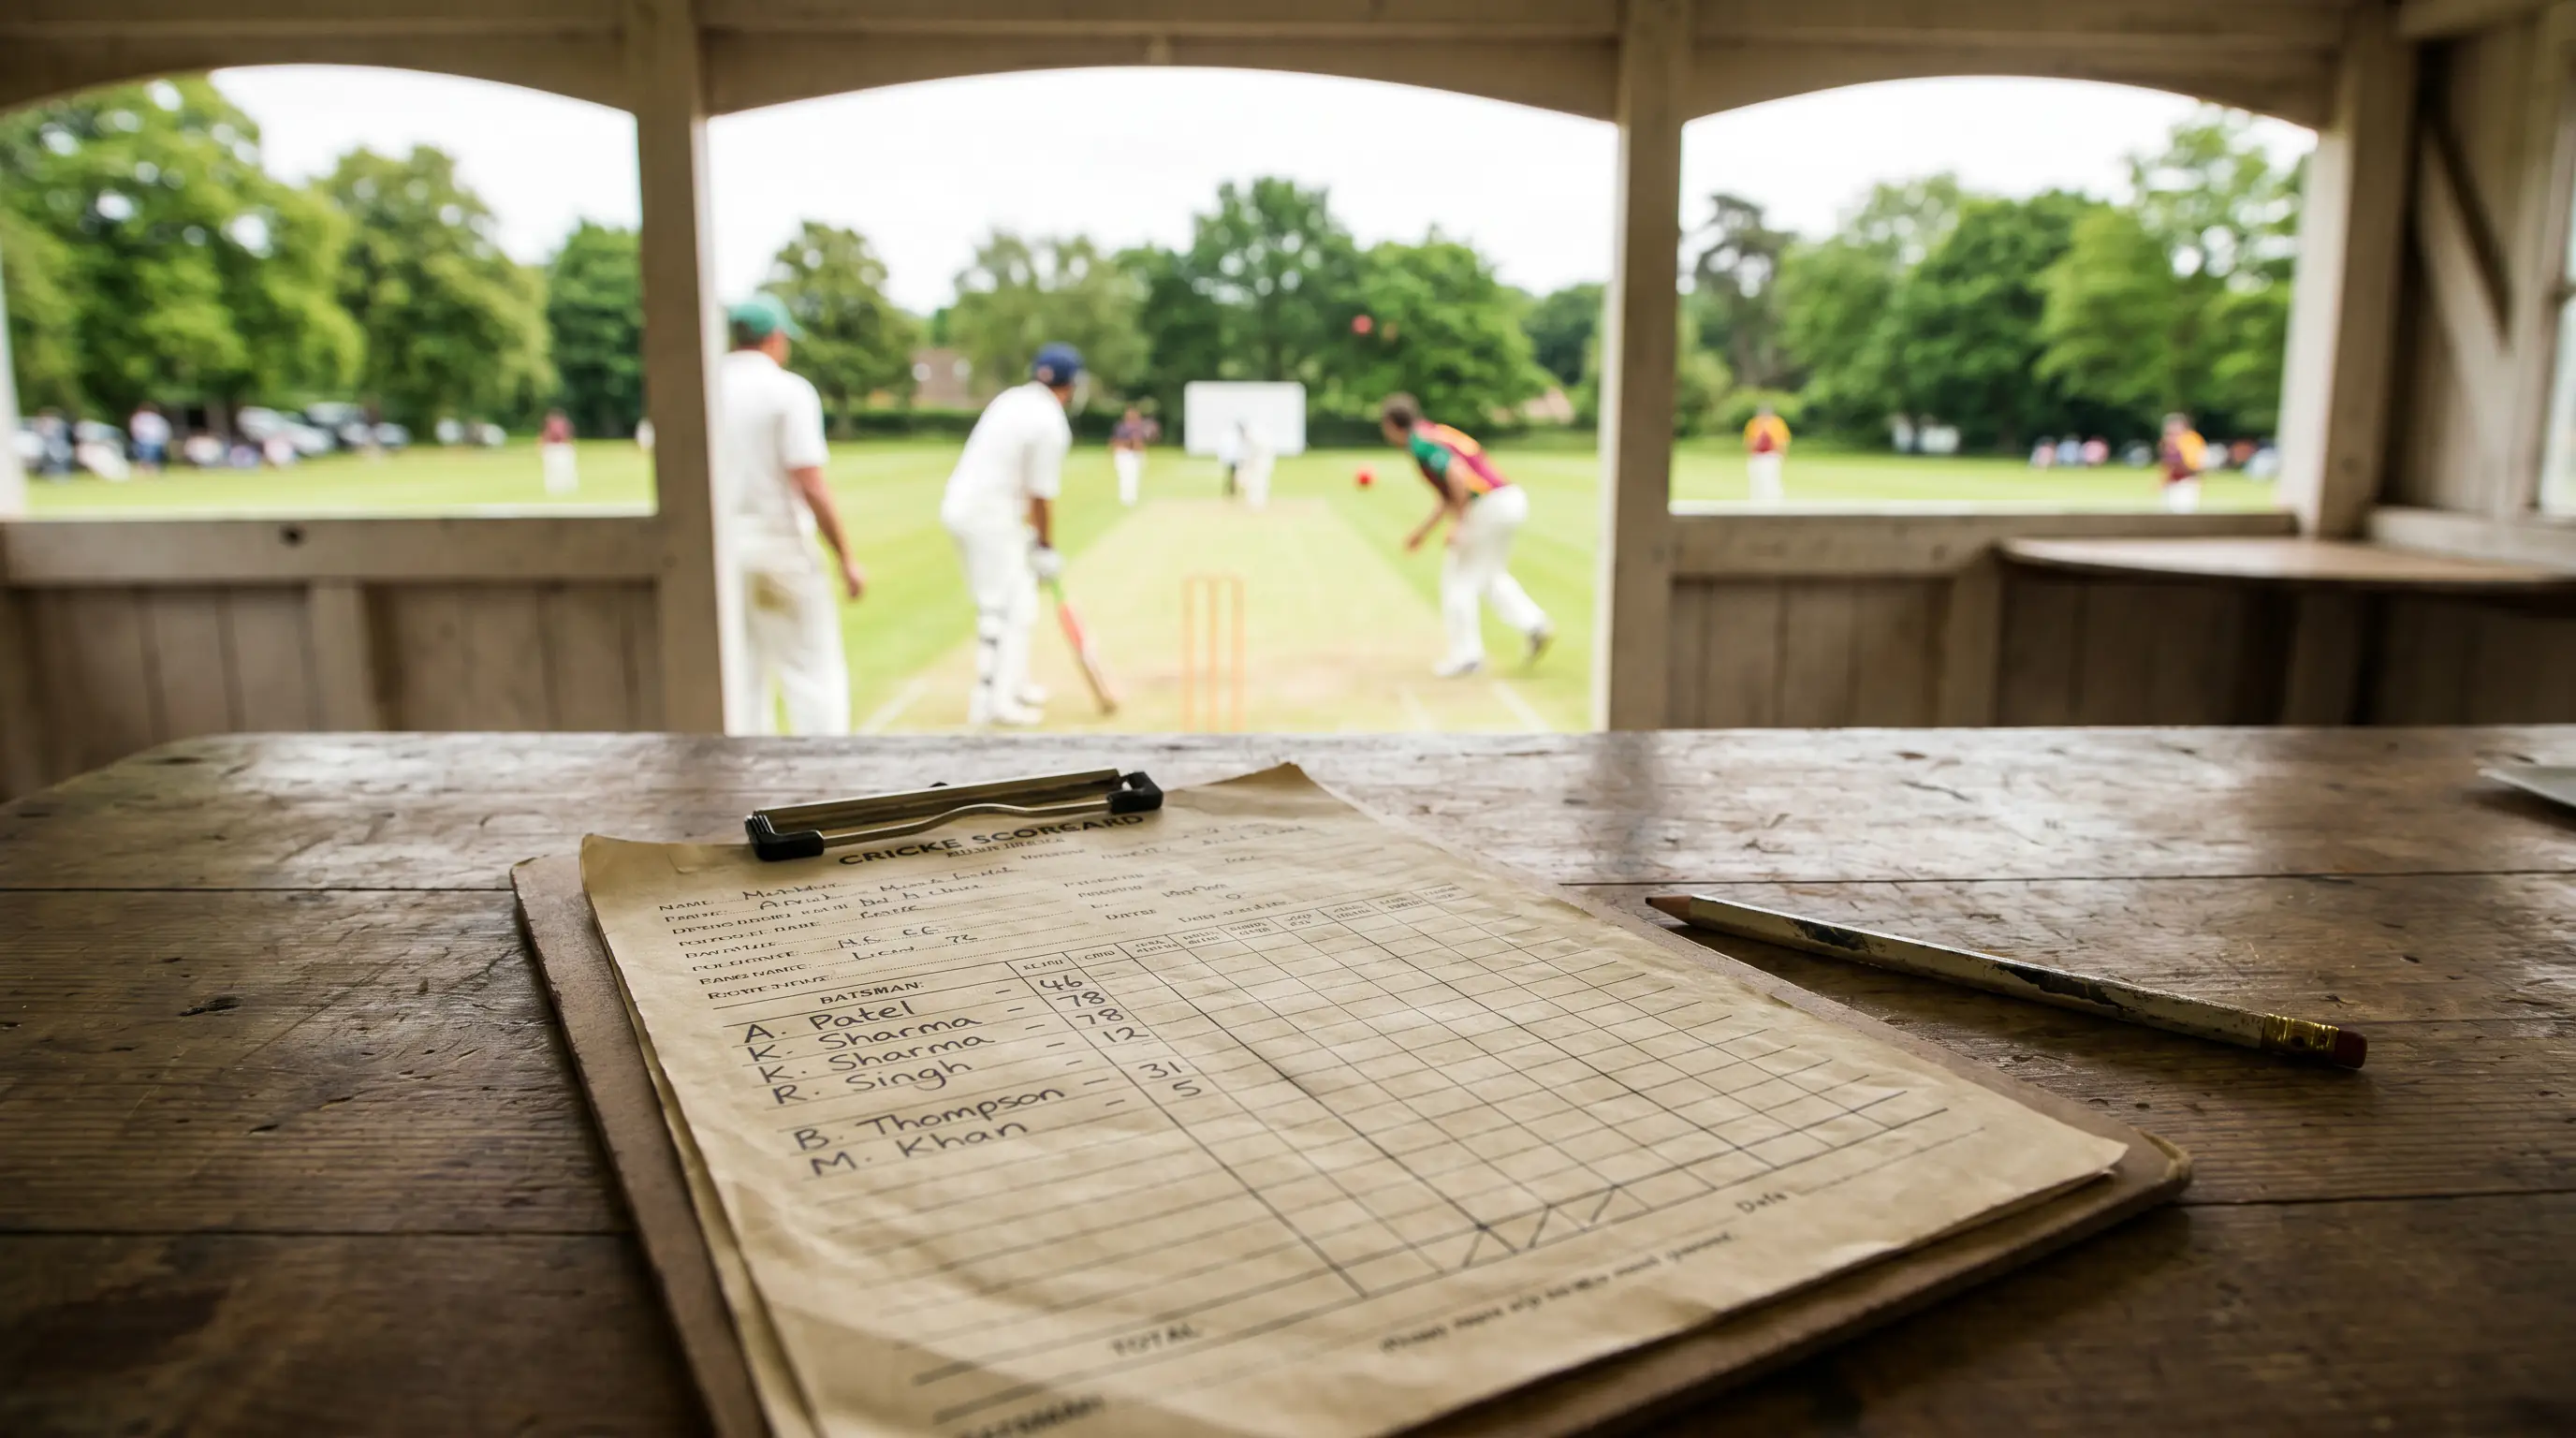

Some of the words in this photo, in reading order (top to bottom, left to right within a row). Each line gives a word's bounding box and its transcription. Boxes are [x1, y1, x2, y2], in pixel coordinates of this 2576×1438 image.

[744, 1023, 787, 1044] A.
[809, 1000, 915, 1031] Patel
[1040, 975, 1083, 990] 46
[747, 1044, 794, 1063] K.
[818, 1017, 983, 1050] Sharma
[1056, 990, 1105, 1007] 78
[820, 981, 924, 1005] BATSMAN:
[758, 1064, 807, 1084] K.
[827, 1034, 996, 1072] Sharma
[1076, 1007, 1124, 1025] 78
[771, 1084, 820, 1105] R.
[845, 1059, 973, 1092] Singh
[1103, 1026, 1149, 1043] 12
[794, 1128, 843, 1151] B.
[856, 1087, 1065, 1136] Thompson
[1138, 1061, 1182, 1078] 31
[810, 1152, 872, 1177] M.
[896, 1122, 1029, 1158] Khan
[1172, 1079, 1202, 1097] 5
